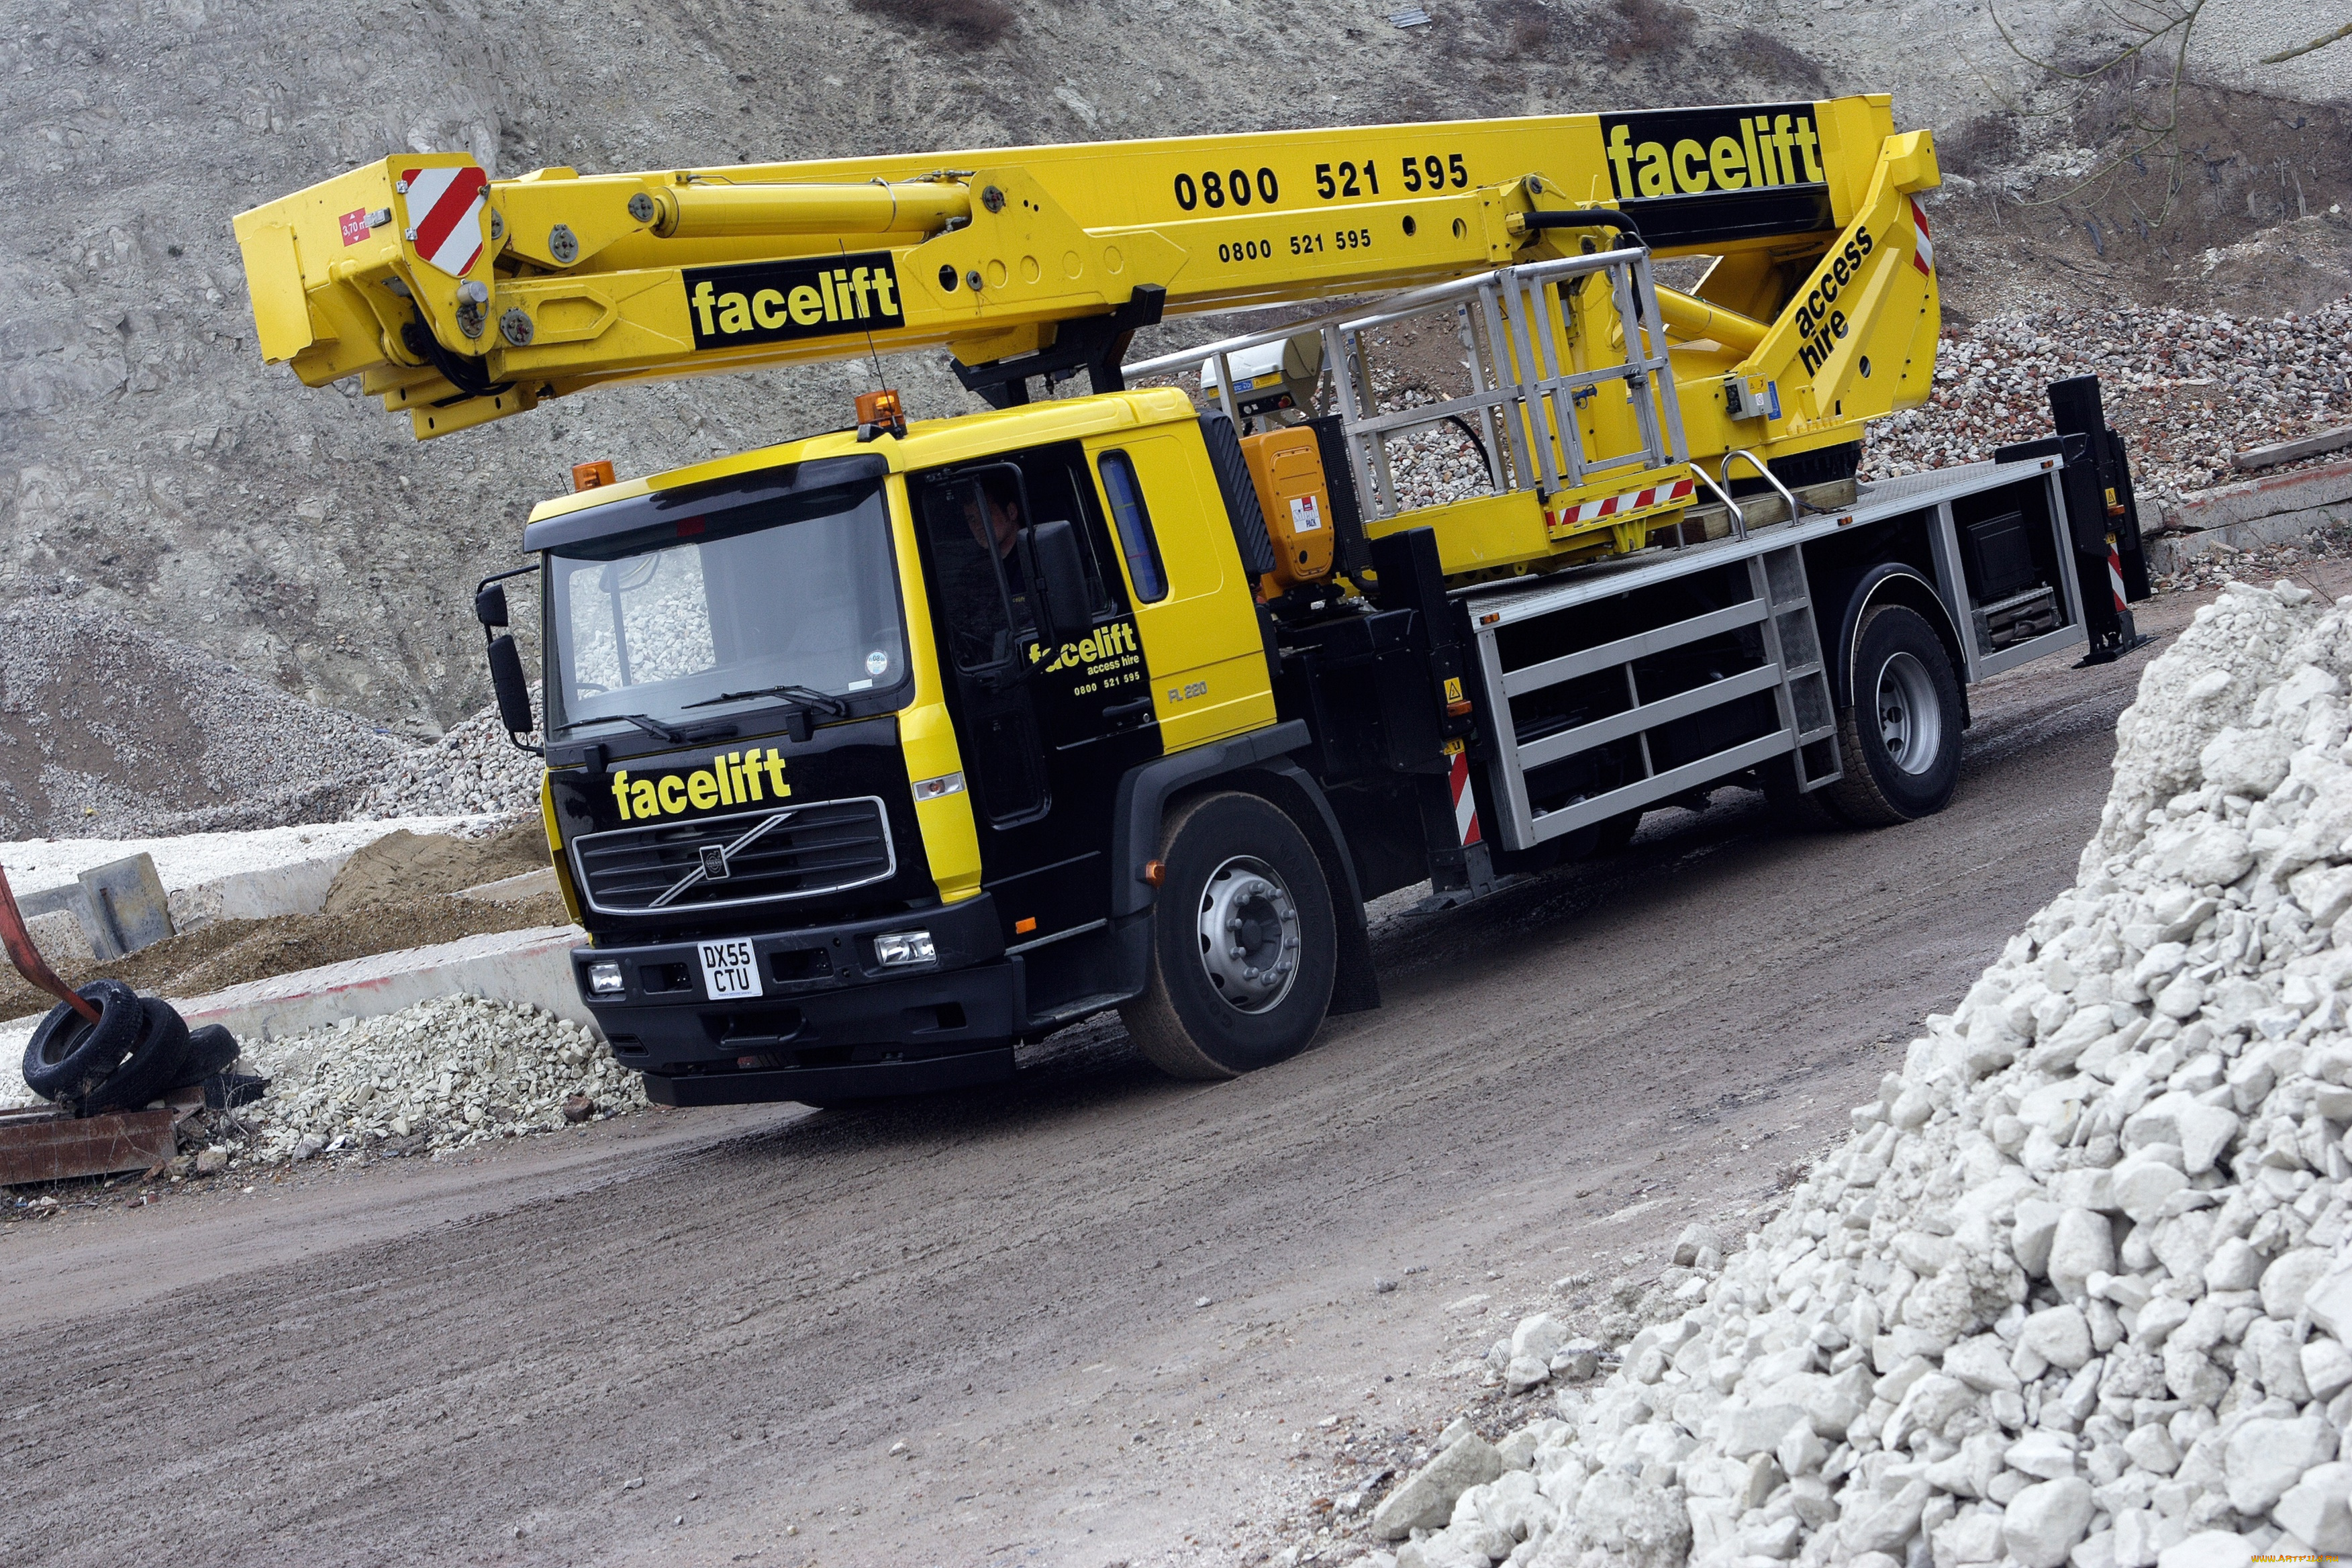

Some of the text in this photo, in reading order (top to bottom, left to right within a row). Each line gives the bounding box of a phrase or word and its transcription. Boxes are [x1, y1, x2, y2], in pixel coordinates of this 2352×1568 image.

[1607, 113, 1825, 199] facelift
[1175, 153, 1468, 211] 0800 521 595
[342, 222, 358, 237] 3,70
[1219, 229, 1371, 263] 0800 521 595
[691, 266, 899, 336] facelift
[1795, 226, 1873, 340] access
[1798, 309, 1849, 379] hire
[1029, 622, 1137, 673] facelift
[1087, 654, 1140, 676] access hire
[1074, 671, 1140, 696] 0800 521 595
[1168, 681, 1208, 703] FL 220
[611, 747, 791, 820] facelift
[703, 942, 750, 968] DX55
[714, 968, 750, 992] CTU
